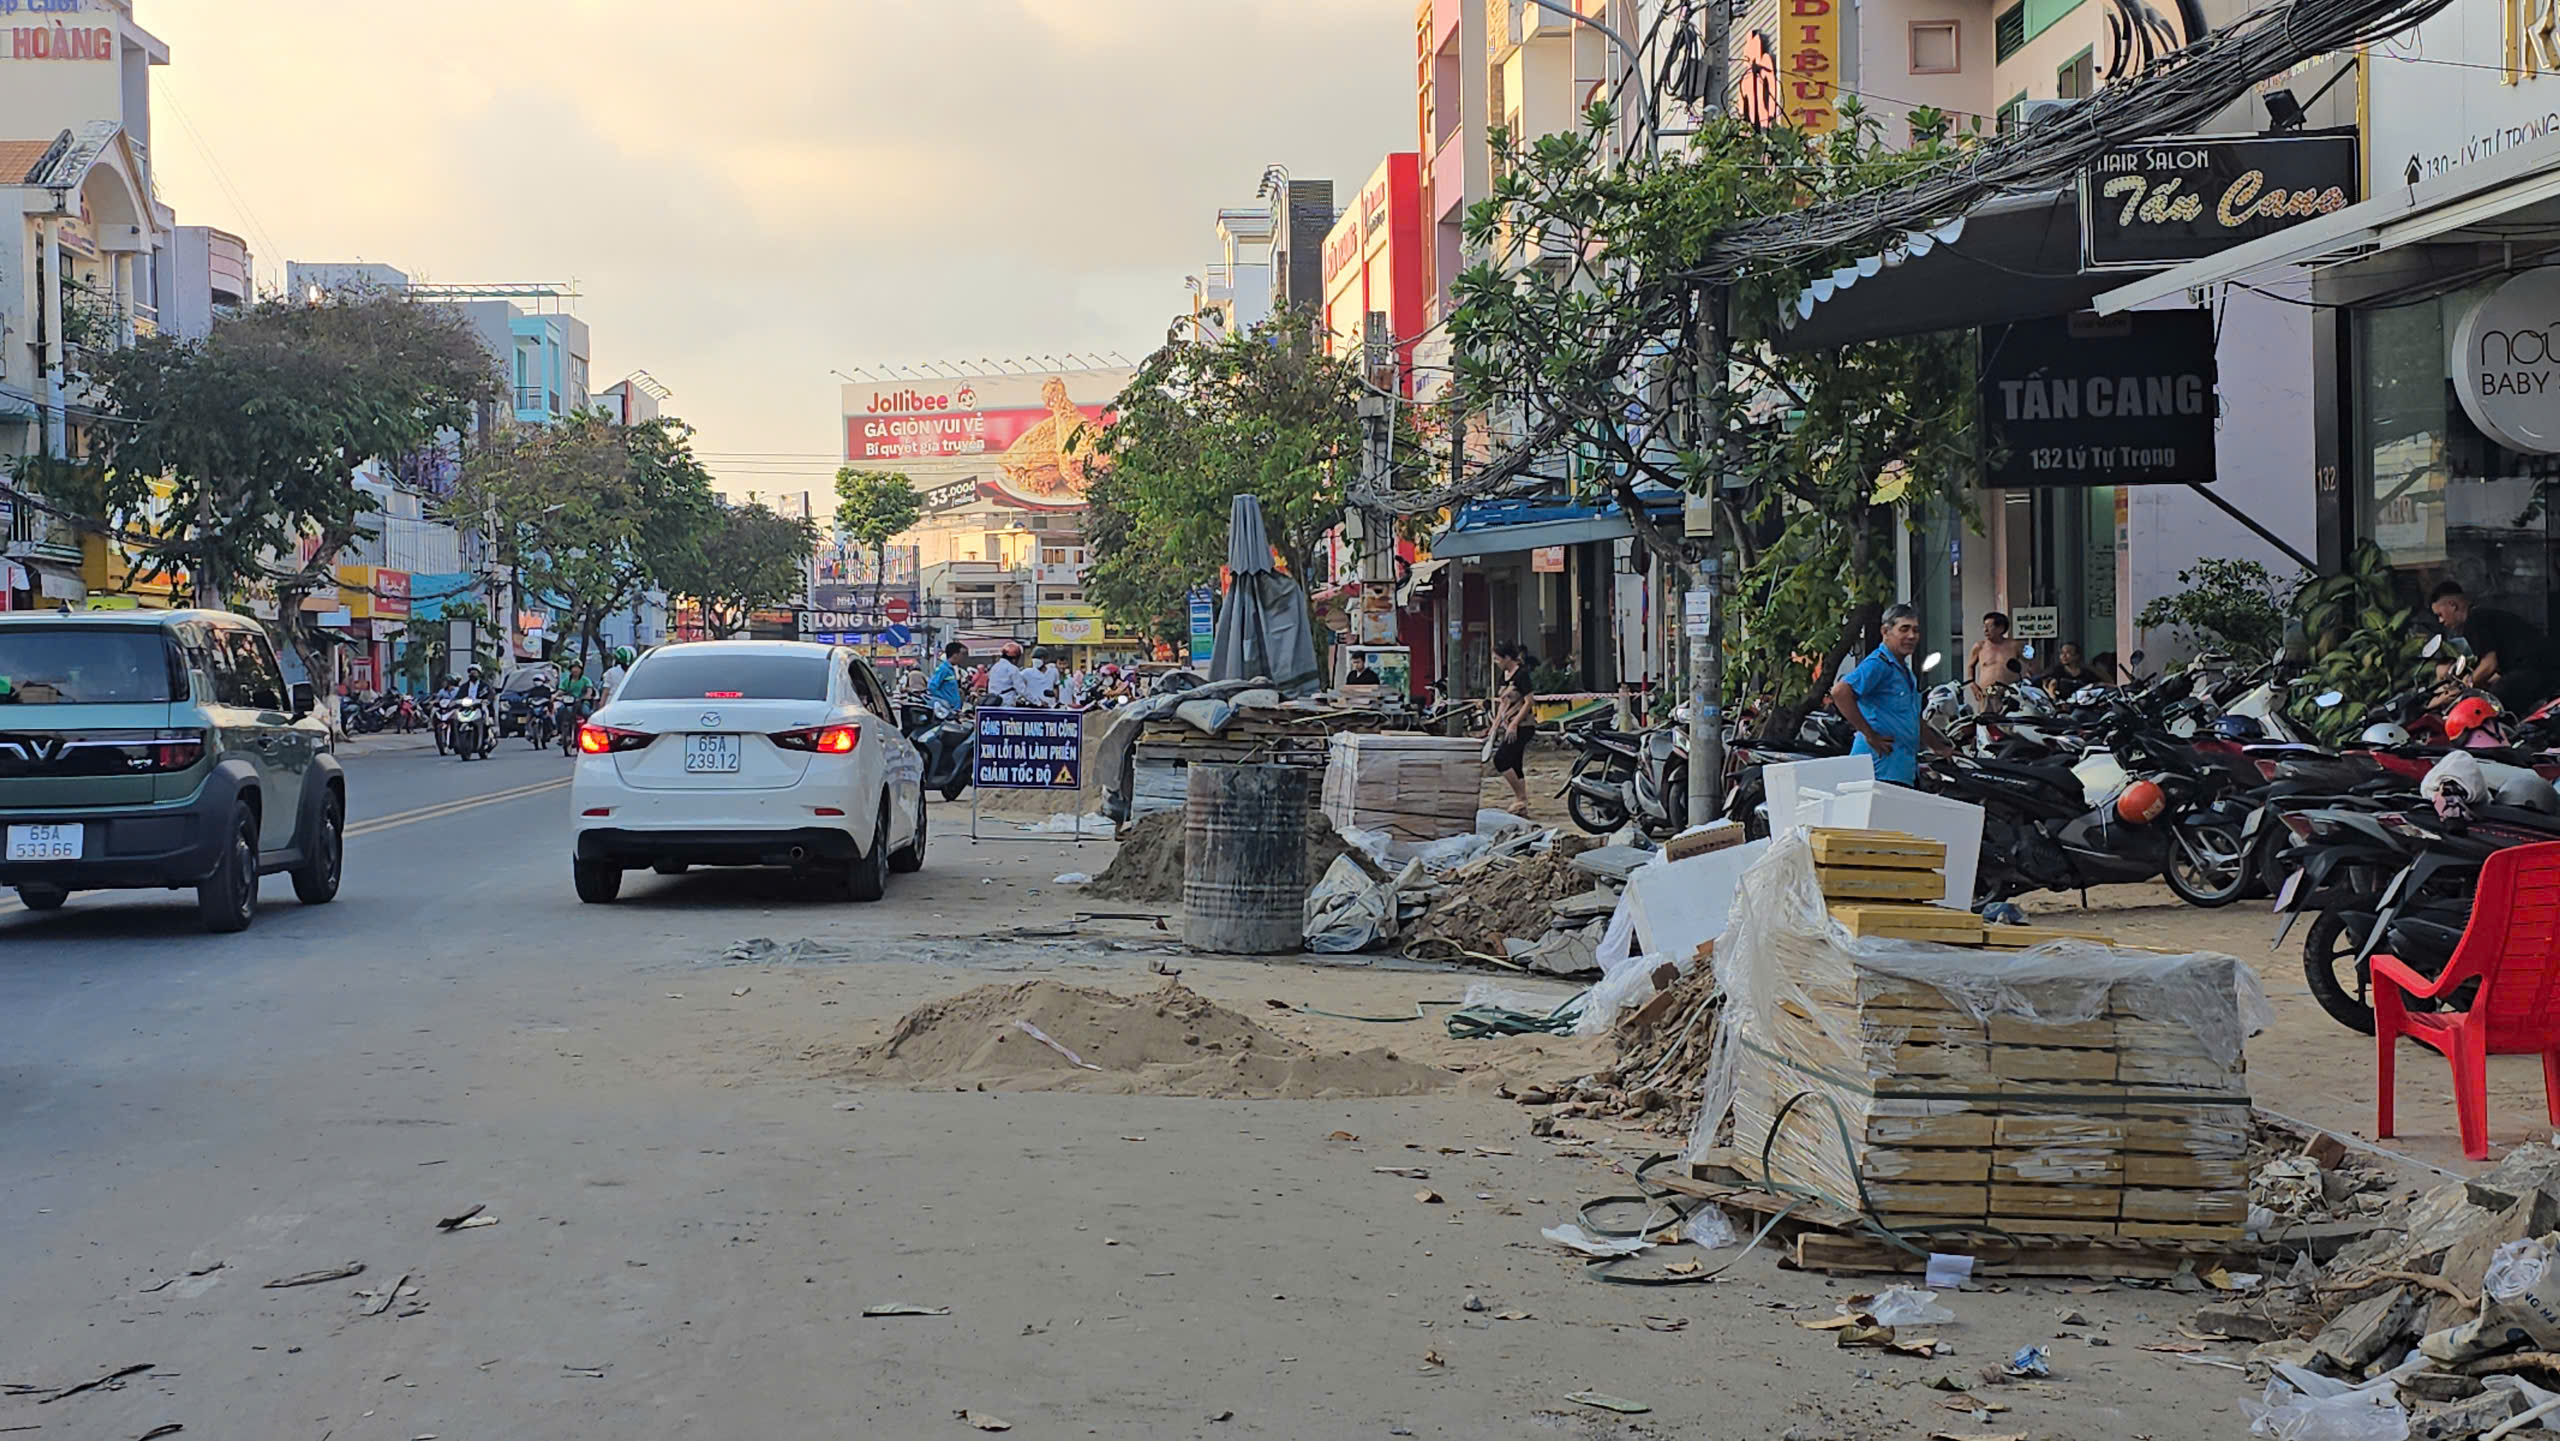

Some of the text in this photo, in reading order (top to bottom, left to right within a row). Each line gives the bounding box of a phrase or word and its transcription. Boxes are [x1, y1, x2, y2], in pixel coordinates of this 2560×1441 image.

[12, 19, 112, 60] HOÀNG
[2103, 175, 2203, 227] Tấn
[1999, 366, 2203, 420] TẤN CANG
[2481, 371, 2550, 396] BABY
[866, 388, 949, 414] Jollibee
[933, 418, 962, 434] VUI
[865, 441, 879, 456] Bí
[2030, 445, 2176, 473] 132 Lý Tự Trọng
[2318, 465, 2336, 492] 132
[836, 593, 857, 606] NHÀ
[814, 611, 918, 628] LONG CHU
[981, 716, 1000, 736] CÔNG
[1001, 716, 1023, 736] TRÌNH
[1045, 721, 1058, 737] THI
[1058, 718, 1078, 738] CÔNG
[699, 736, 727, 753] 65A
[980, 743, 996, 759] XIN
[1029, 741, 1048, 760] LÀM
[687, 754, 737, 770] 239.12
[980, 761, 1052, 787] GIẢM TỐC ĐỘ
[30, 826, 60, 841] 65A
[16, 843, 73, 858] 533.66
